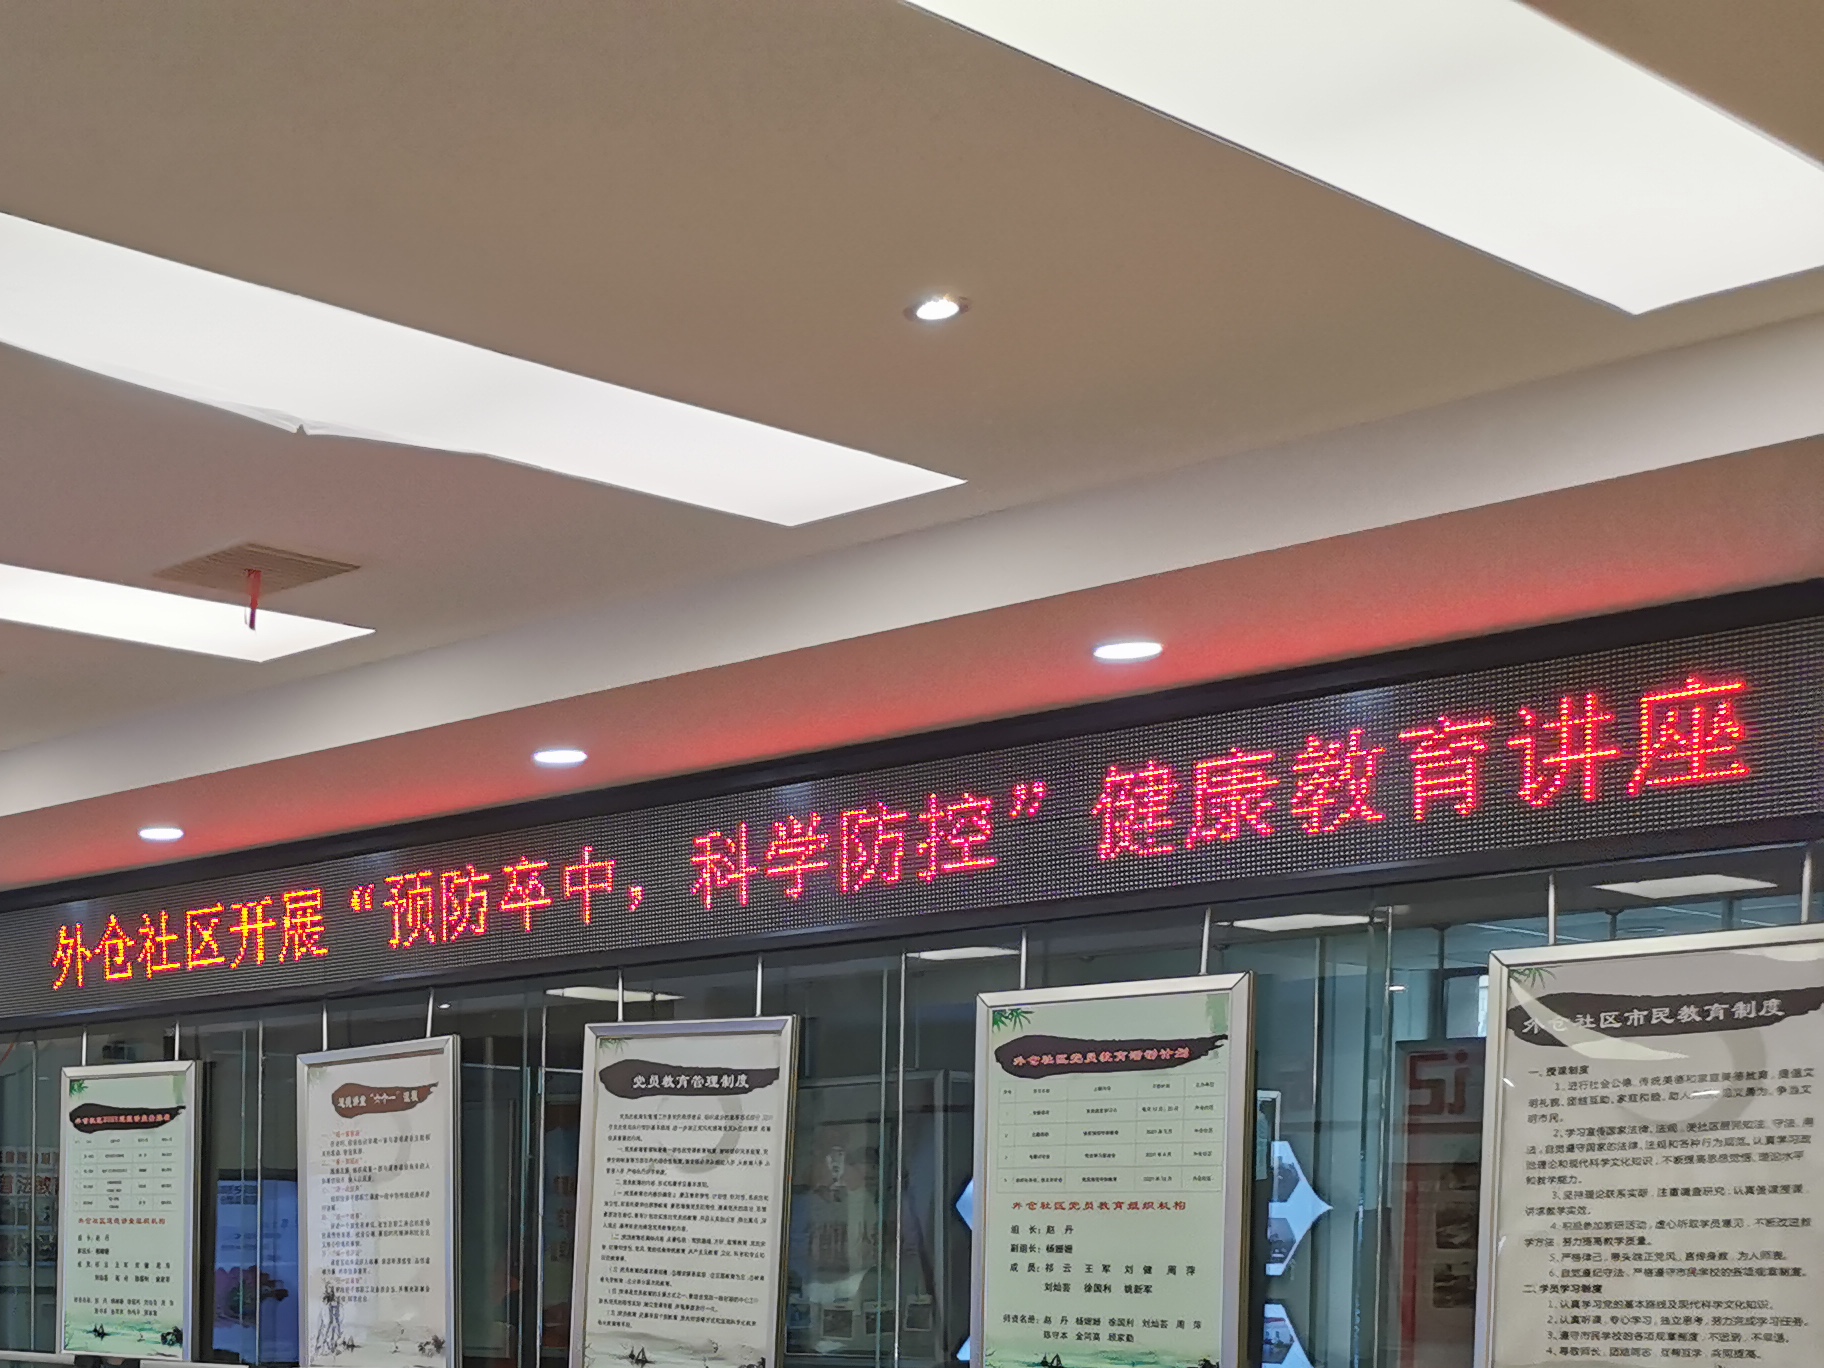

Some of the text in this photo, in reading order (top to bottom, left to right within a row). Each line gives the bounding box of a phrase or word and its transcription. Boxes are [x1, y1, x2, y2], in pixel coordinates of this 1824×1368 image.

[1522, 998, 1786, 1034] 外仓社区市民教育制度
[632, 1073, 750, 1089] 党员教育管理制度
